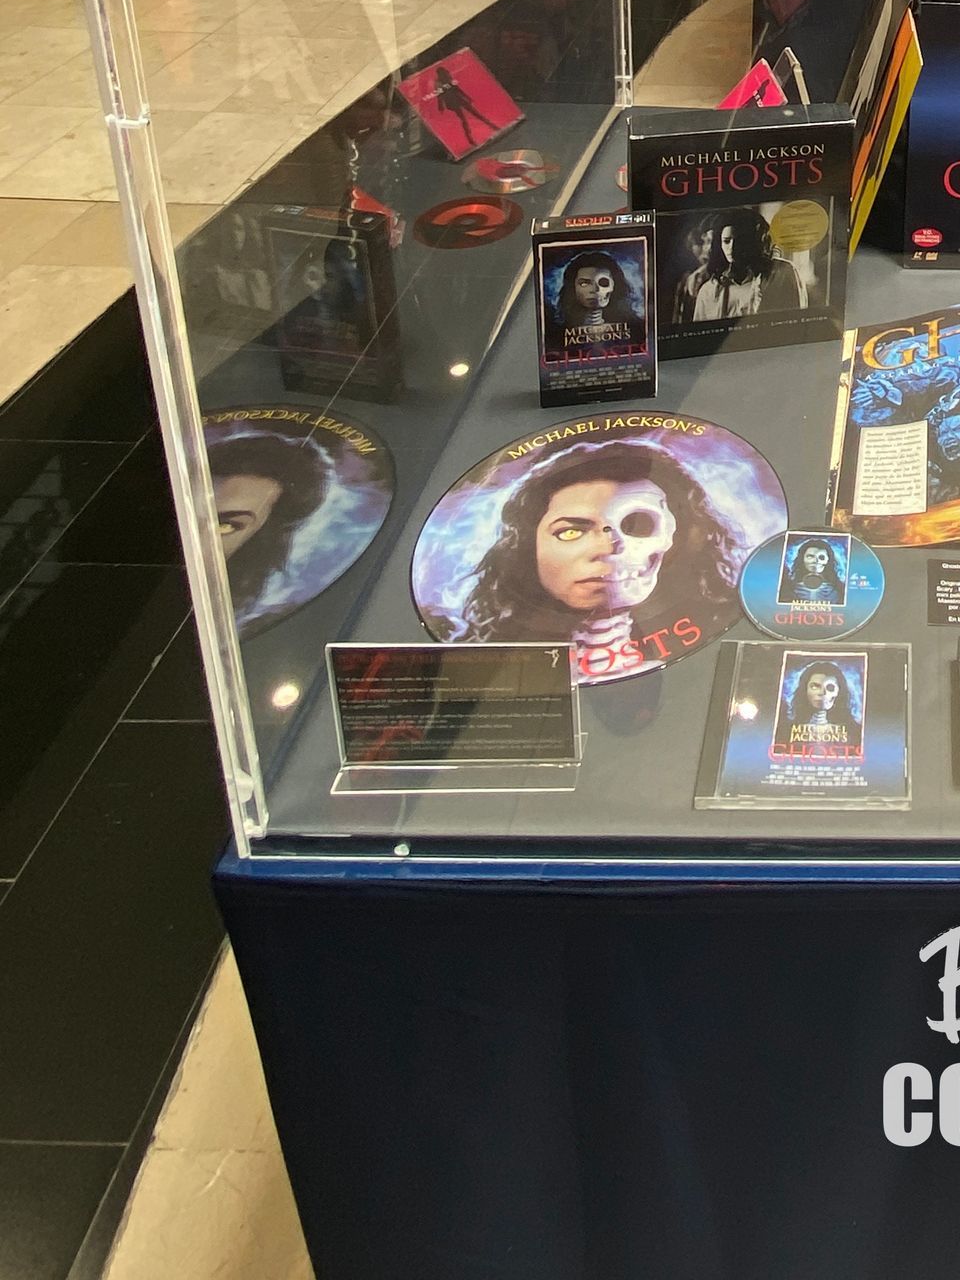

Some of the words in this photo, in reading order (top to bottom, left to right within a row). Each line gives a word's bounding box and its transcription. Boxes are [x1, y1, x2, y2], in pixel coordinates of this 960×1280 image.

[661, 150, 741, 168] MICHAEL
[749, 143, 826, 161] JACKSON
[660, 158, 824, 197] GHOSTS
[564, 322, 631, 337] MICHAEL
[564, 331, 631, 347] JACKSON'S
[506, 420, 600, 460] MICHAEL
[604, 415, 706, 437] JACKSON'S
[774, 612, 845, 626] GHOSTS
[579, 617, 702, 677] OSTS
[790, 723, 848, 735] MICHAEL
[790, 731, 848, 743] JACKSON'S
[767, 742, 865, 765] GHOSTS
